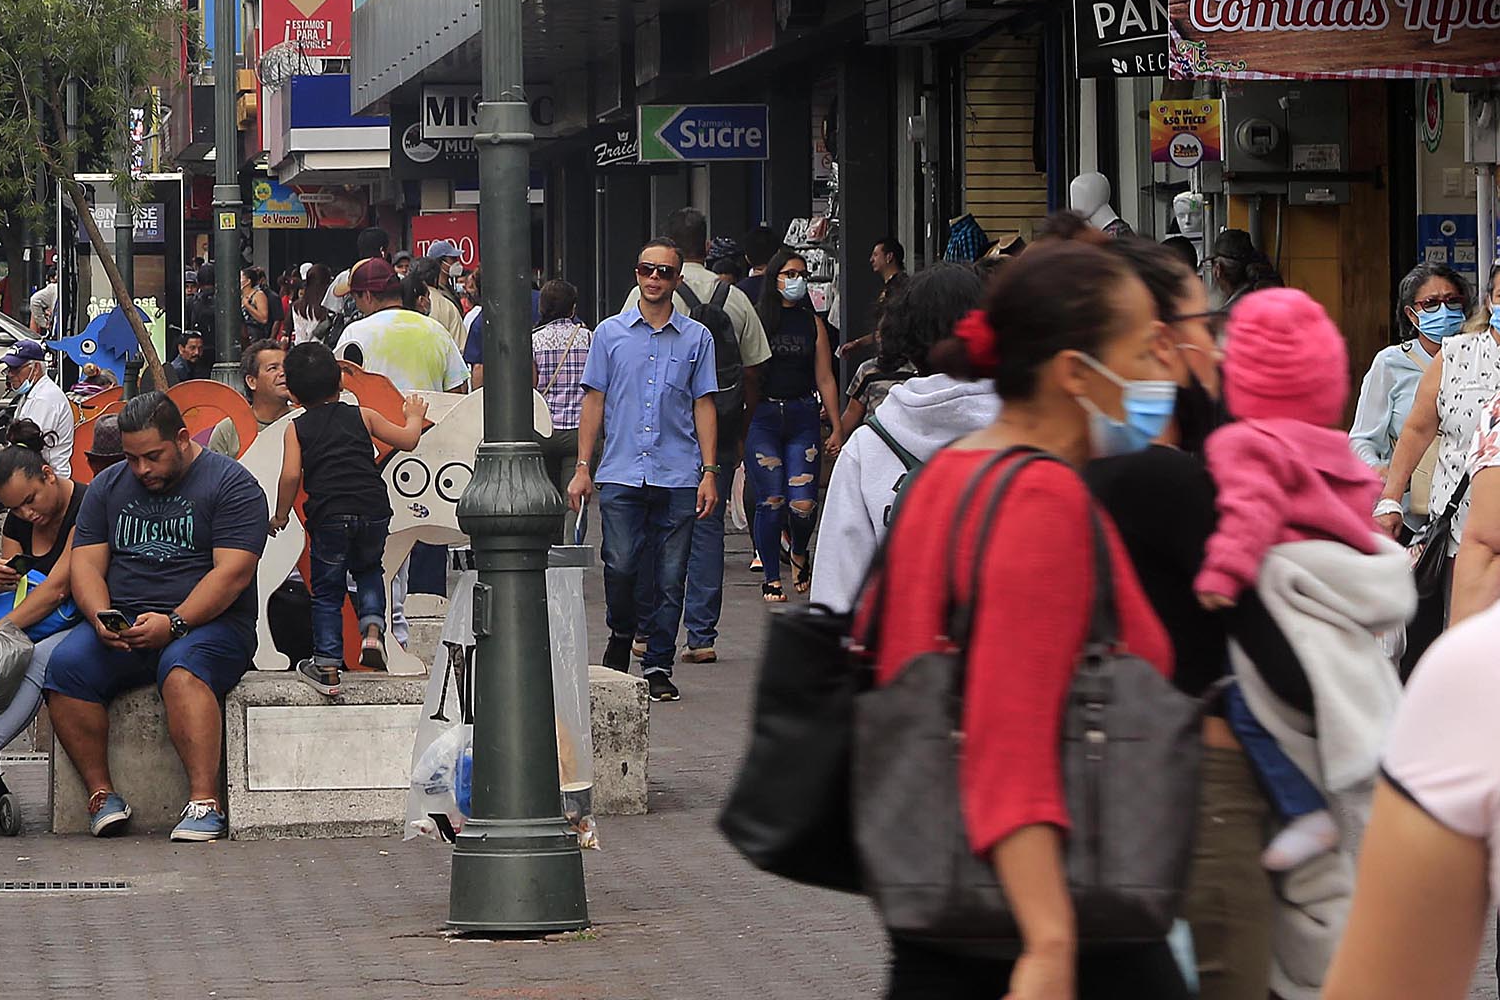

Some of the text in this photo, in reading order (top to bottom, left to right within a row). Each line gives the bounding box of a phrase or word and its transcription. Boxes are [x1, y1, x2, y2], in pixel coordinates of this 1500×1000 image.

[296, 30, 319, 41] PARA
[679, 119, 763, 149] Sucre
[262, 213, 272, 224] de
[115, 513, 195, 551] QUIKSILVER
